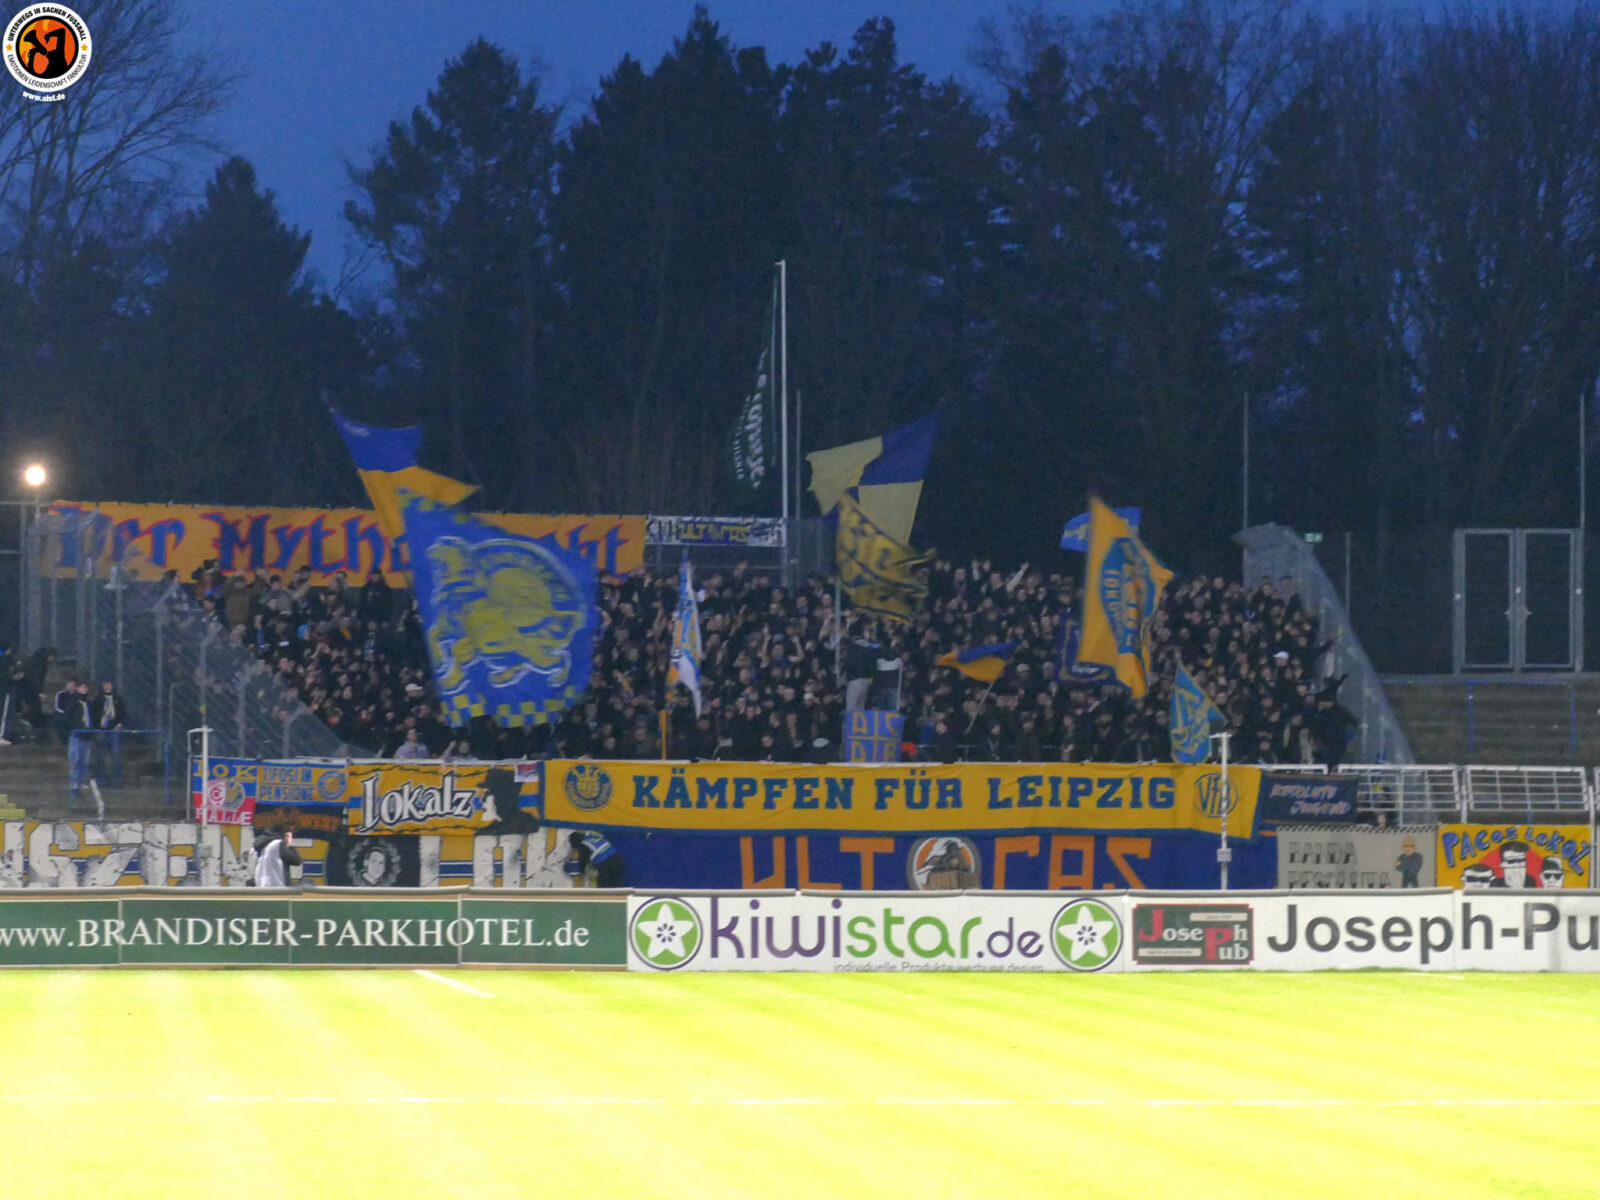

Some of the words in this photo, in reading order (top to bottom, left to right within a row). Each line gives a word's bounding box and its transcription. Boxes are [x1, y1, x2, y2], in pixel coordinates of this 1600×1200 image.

[632, 767, 855, 811] KÄMPFEN
[874, 769, 964, 810] FÜR
[987, 774, 1176, 810] LEIPZIG
[0, 918, 590, 947] www.BRANDISER-PARKHOTEL.de
[710, 896, 1045, 959] kiwistar.de
[1267, 902, 1600, 965] Joseph-Pu
